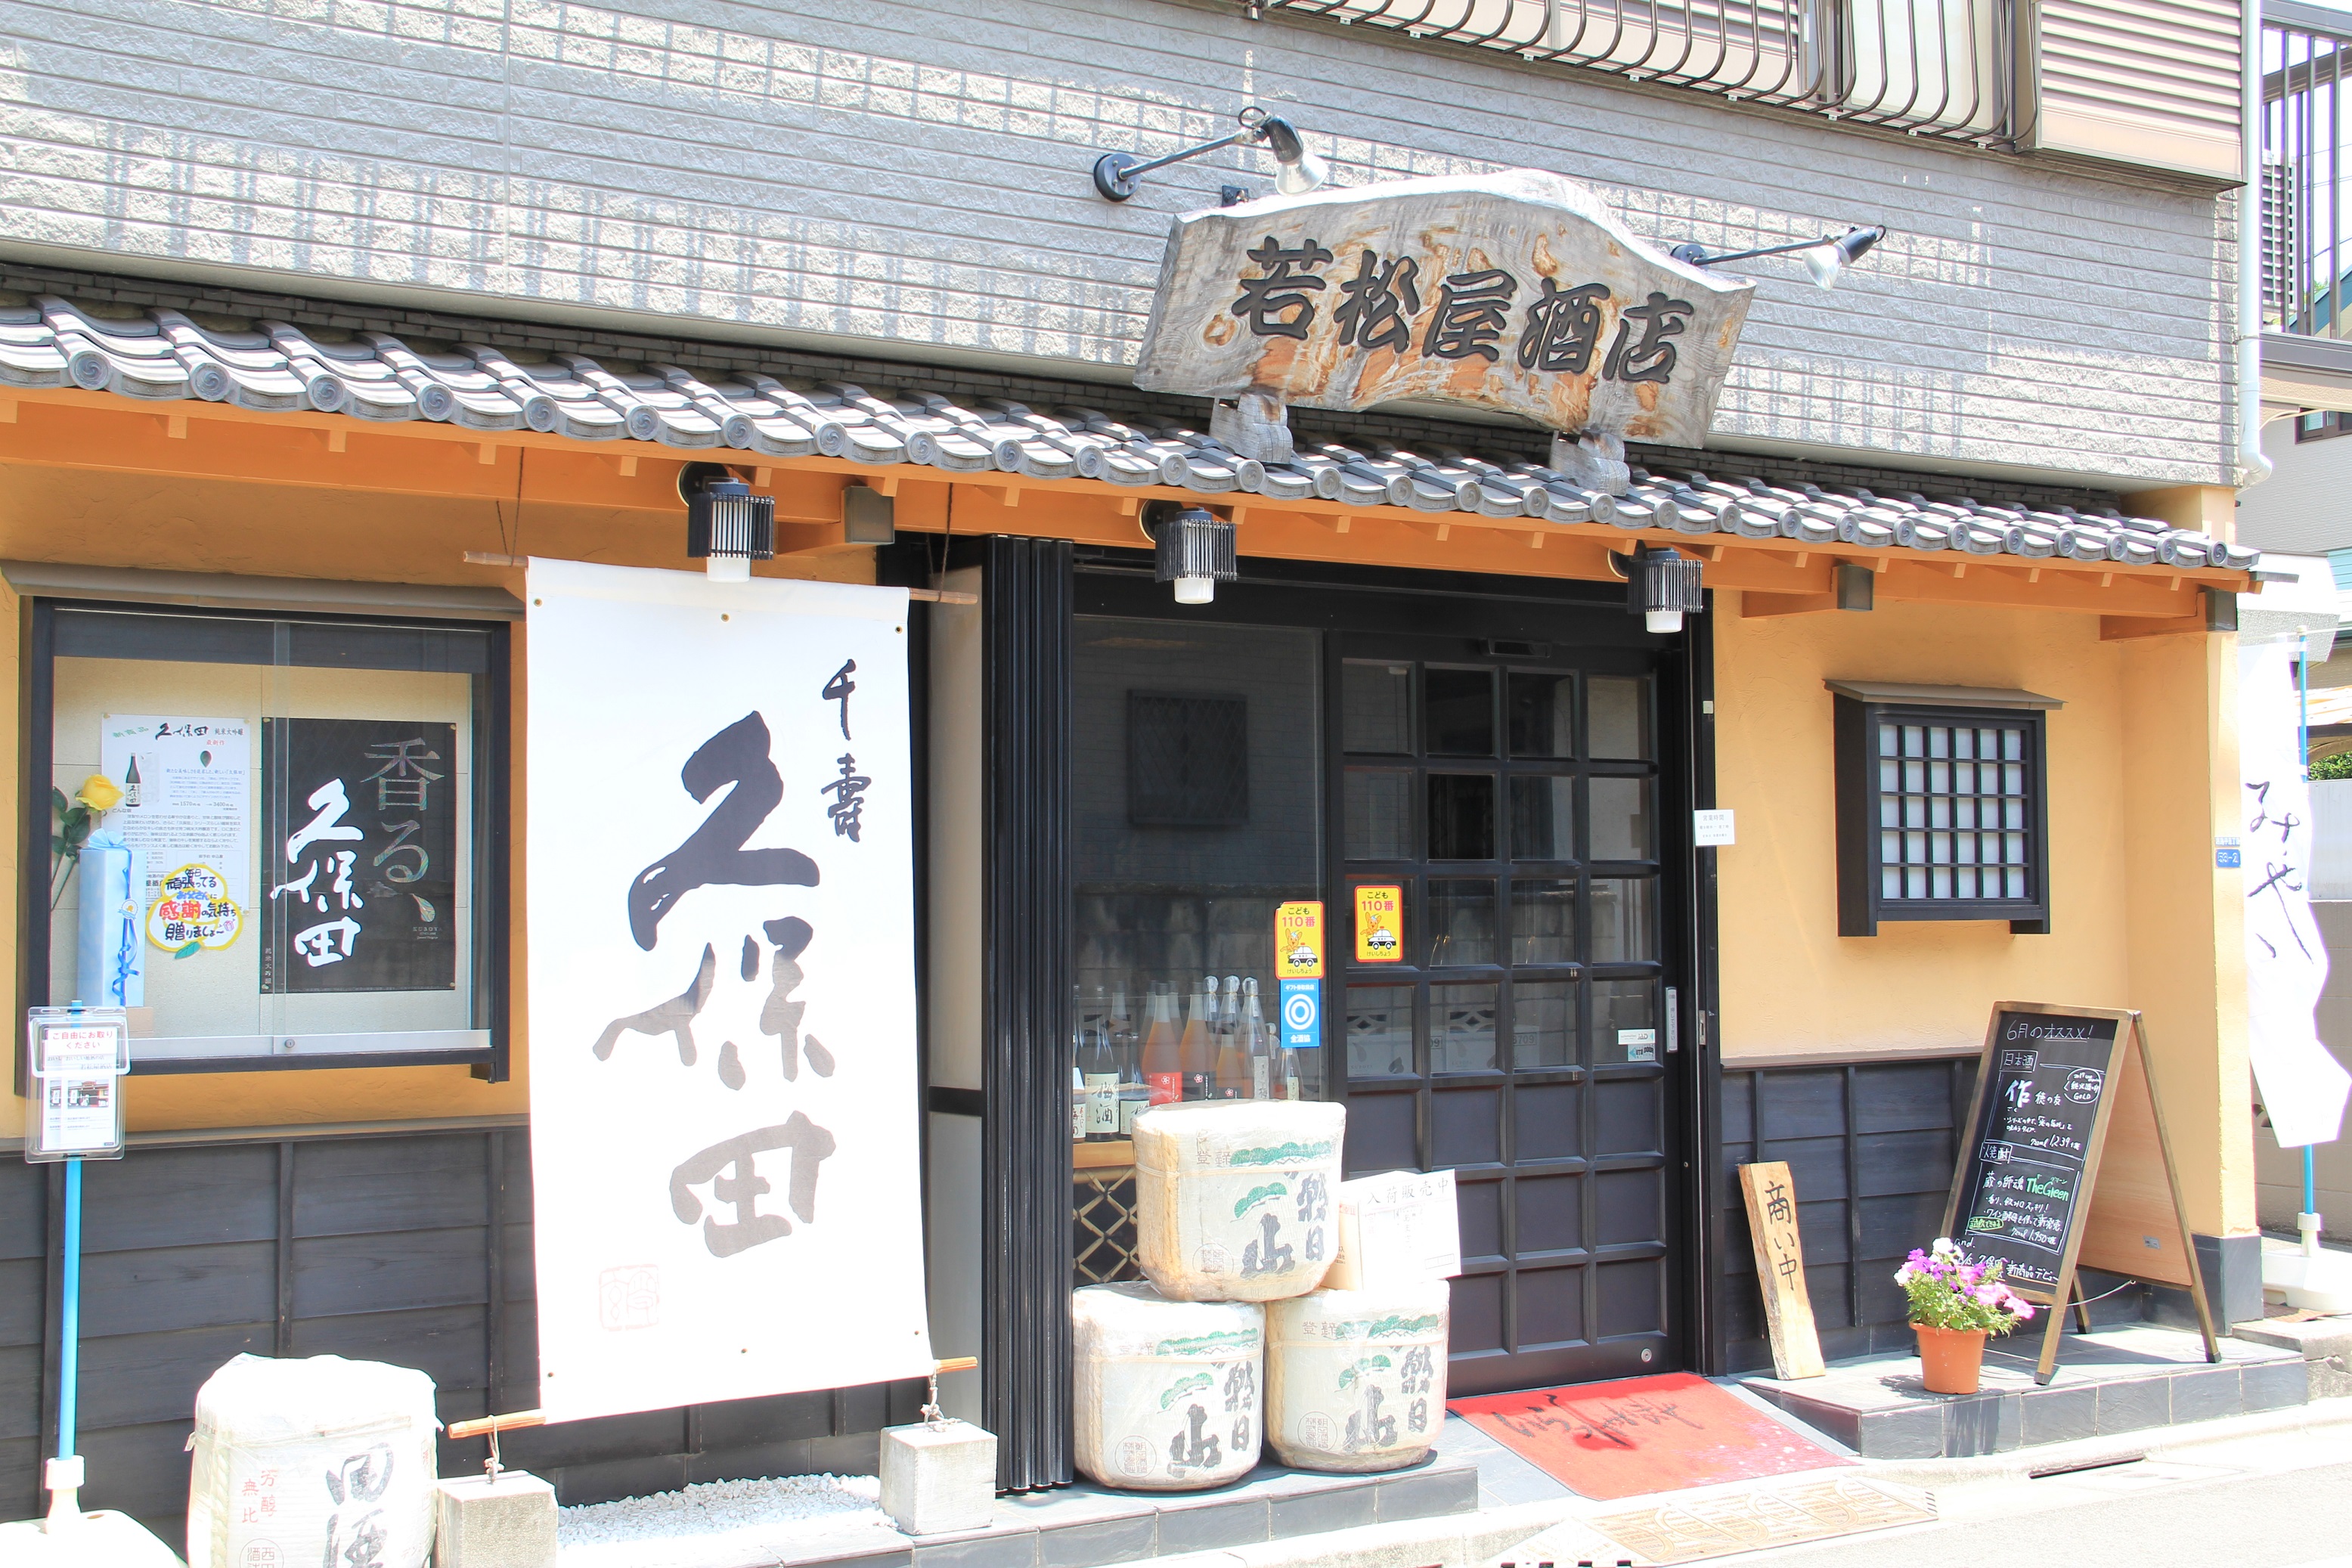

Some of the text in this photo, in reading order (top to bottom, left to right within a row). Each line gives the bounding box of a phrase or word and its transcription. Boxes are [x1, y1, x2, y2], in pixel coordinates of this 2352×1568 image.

[1232, 237, 1694, 383] 若松屋酒店
[155, 722, 209, 741] 久保田
[166, 876, 217, 891] 頑張ってる
[270, 778, 364, 967] 久保田
[159, 900, 236, 920] 感謝の気持ち
[1362, 900, 1394, 911] 110番
[1282, 916, 1315, 927] 110番
[592, 709, 836, 1258] 久保田
[52, 1031, 113, 1040] ご自由にお取り
[1290, 1034, 1311, 1043] 全酒協
[2003, 1052, 2034, 1068] 日本酒
[2005, 1080, 2034, 1108] 作
[1368, 1177, 1449, 1204] 入荷販売中
[1765, 1180, 1798, 1291] 商い中
[242, 1478, 259, 1523] 無比
[261, 1469, 278, 1517] 芳醇
